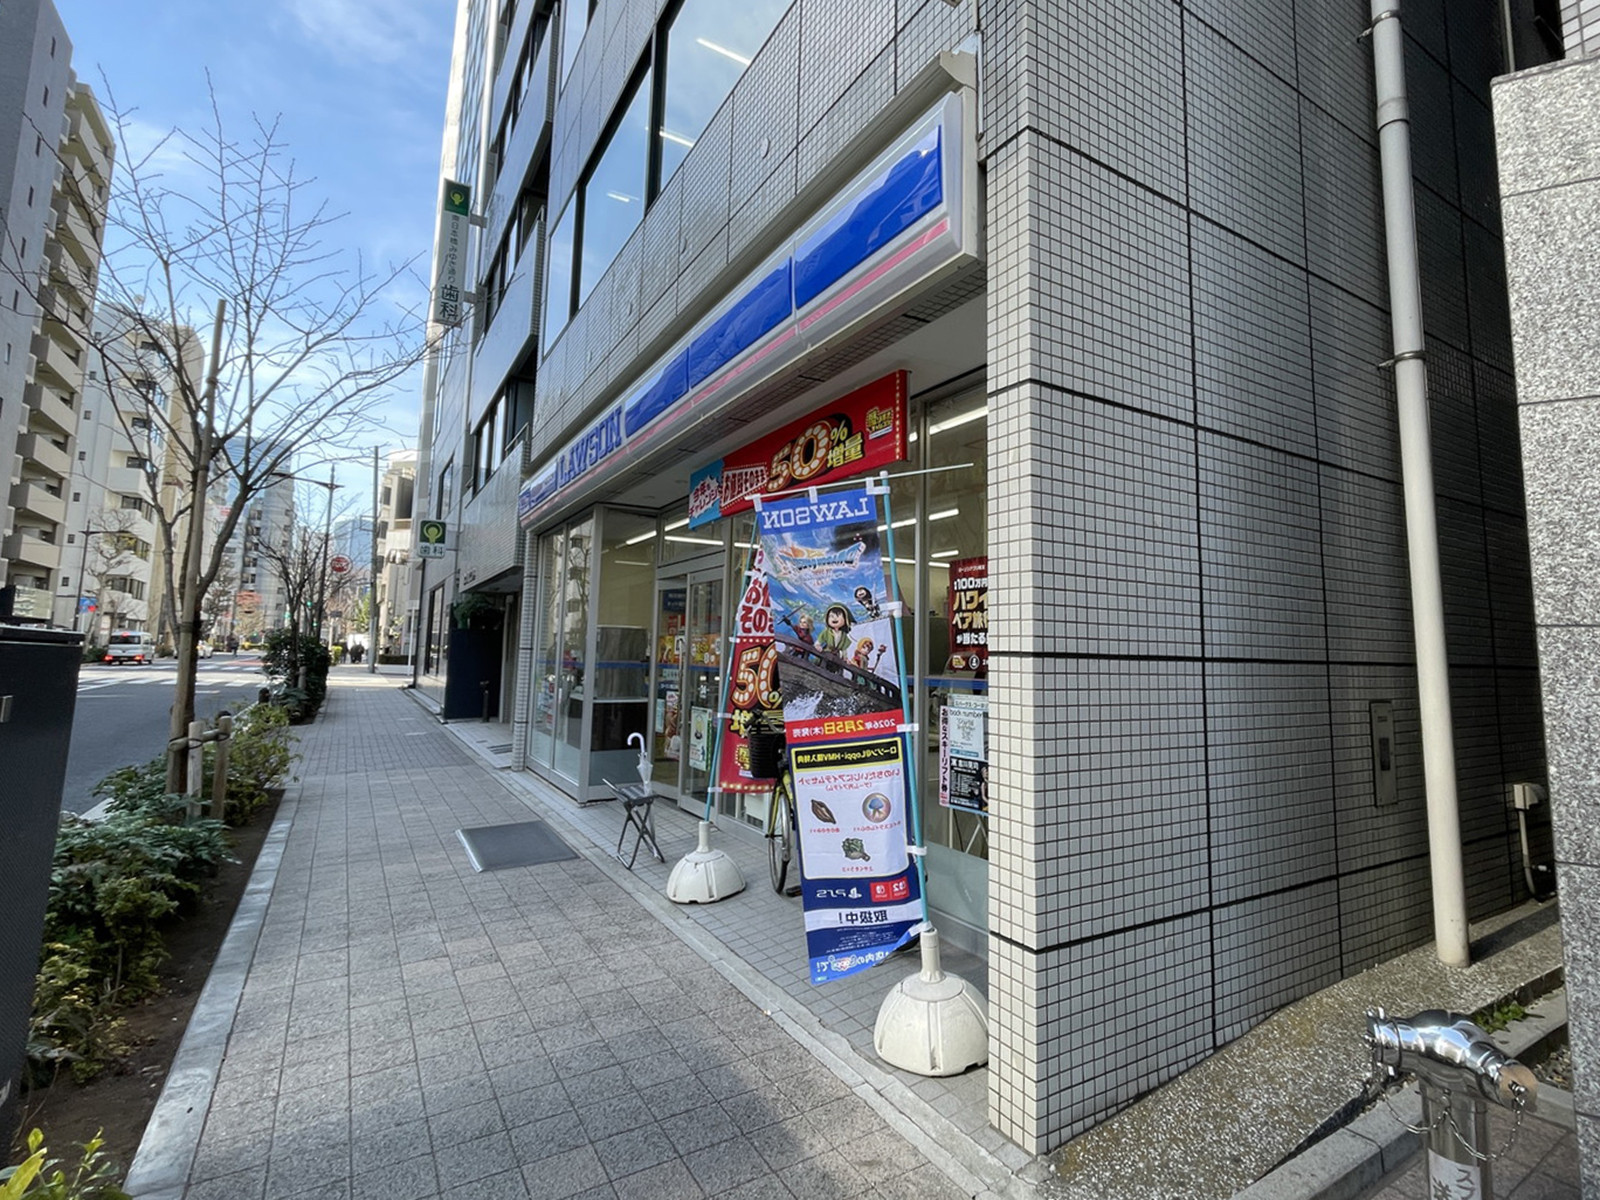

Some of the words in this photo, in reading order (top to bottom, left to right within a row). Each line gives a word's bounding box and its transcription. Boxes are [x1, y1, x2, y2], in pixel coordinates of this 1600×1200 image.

[440, 283, 459, 321] 歯科
[559, 405, 622, 489] LAWSON
[766, 419, 848, 492] 50%
[827, 432, 864, 468] 増量
[420, 545, 443, 555] 歯科
